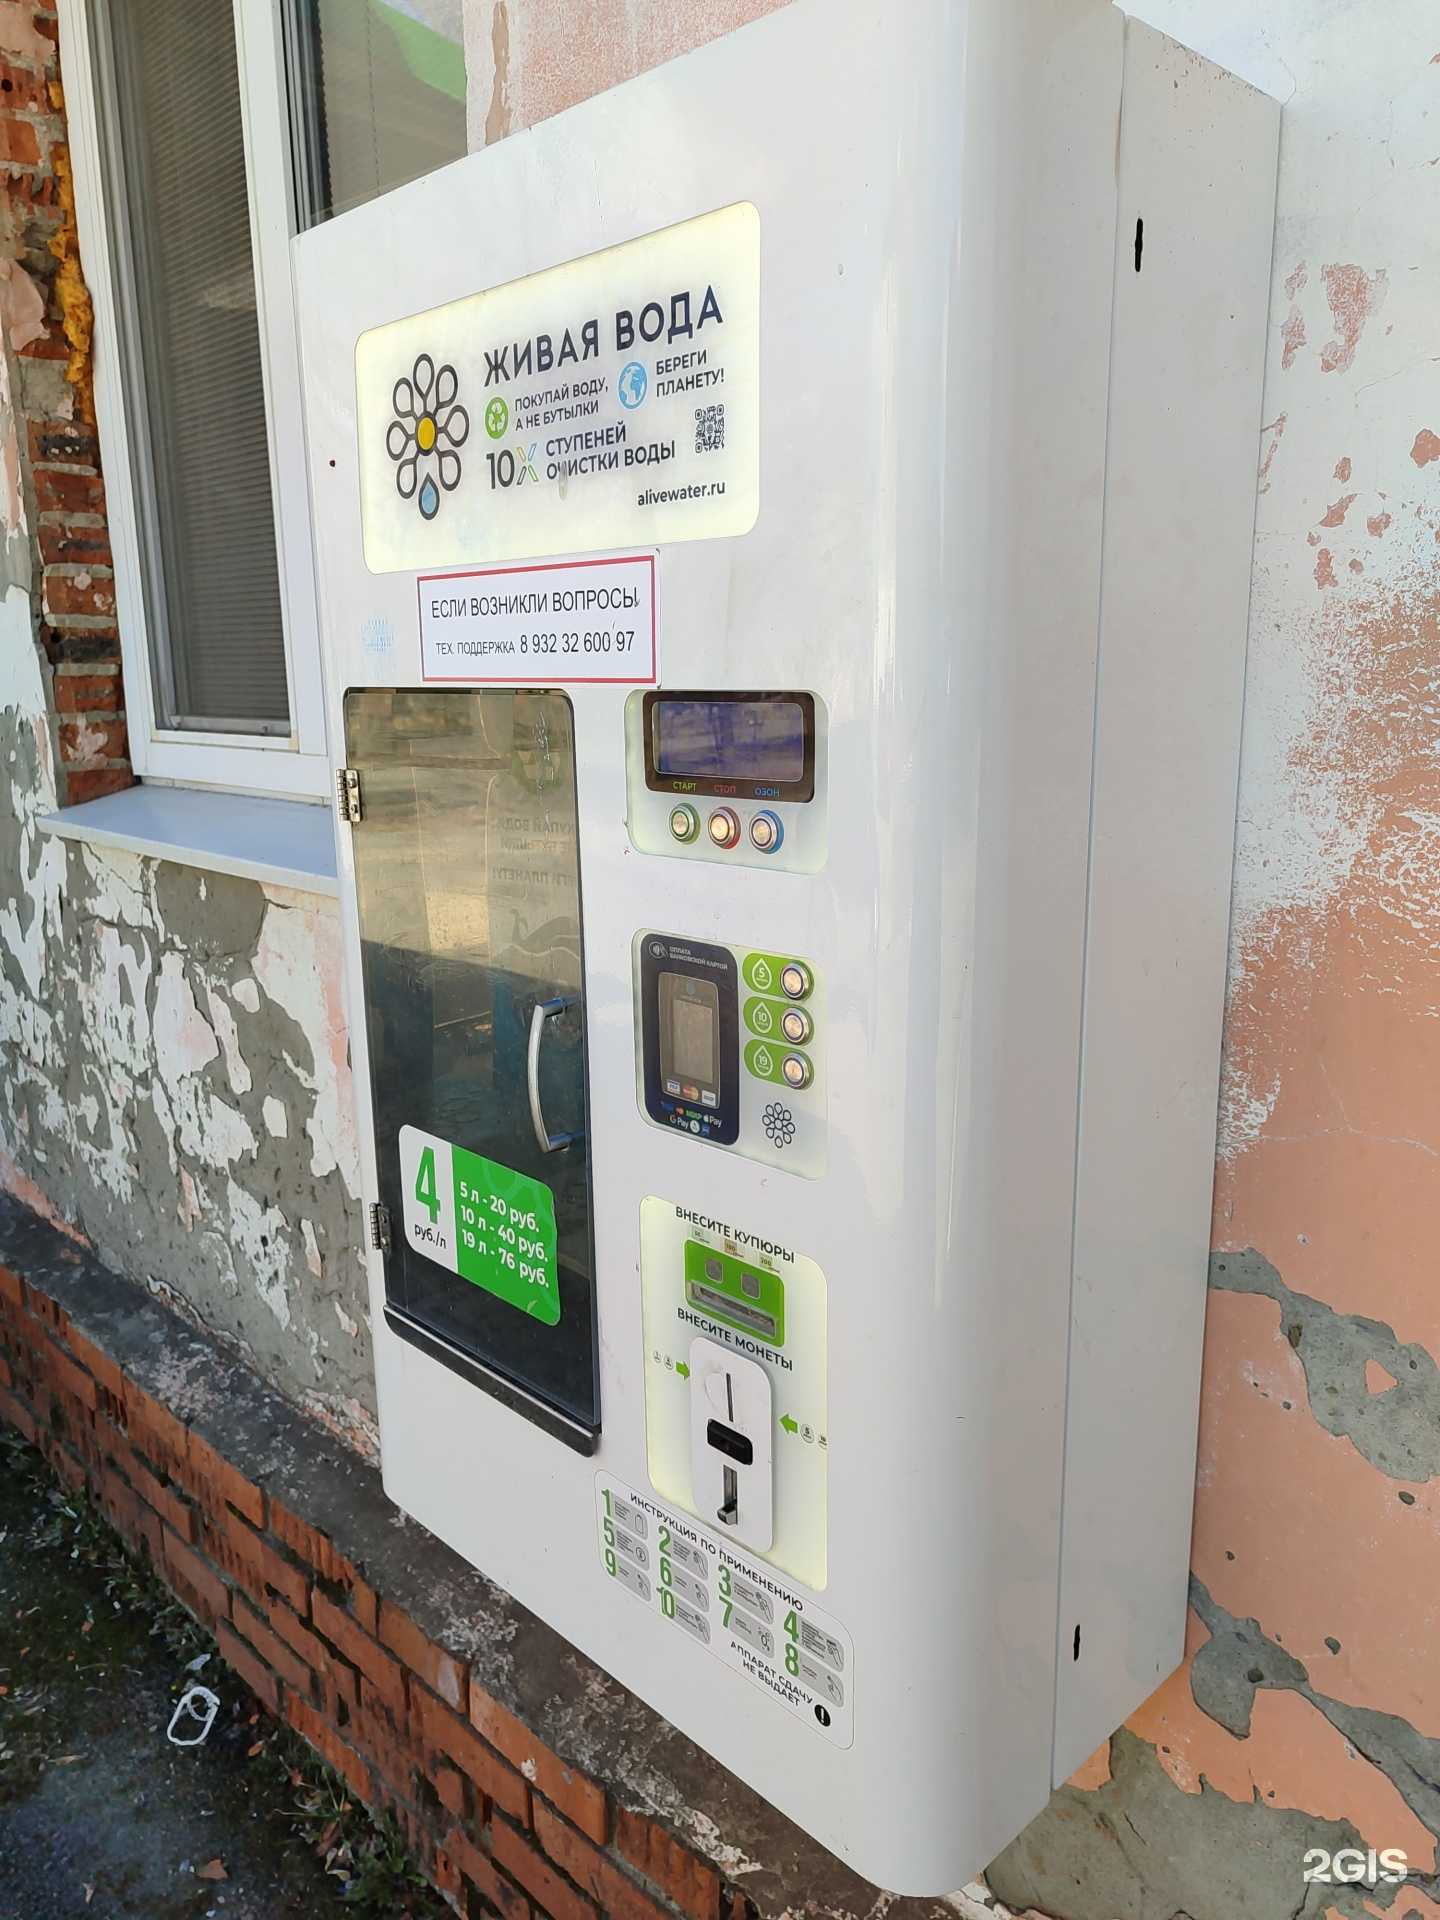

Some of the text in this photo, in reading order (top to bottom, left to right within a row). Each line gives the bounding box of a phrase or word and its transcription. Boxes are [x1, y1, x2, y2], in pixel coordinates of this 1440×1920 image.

[484, 285, 723, 387] ЖИВАЯ ВОДА
[656, 350, 707, 376] БЕРЕГИ
[515, 377, 608, 412] ПОКУПАЙ ВОДУ,
[656, 369, 724, 398] ПЛАНЕТУ!
[515, 400, 599, 431] А НЕ БУТЫЛКИ
[545, 422, 627, 458] СТУПЕНЕЙ
[546, 440, 676, 482] ОЧИСТКИ ВОДЫ
[637, 480, 726, 507] alivewater.ru
[432, 587, 638, 619] ЕСЛИ ВОЗНИКЛИ ВОПРОСЫ
[436, 631, 635, 656] ТЕХ. ПОДДЕРЖКА 8 932 32 600 97
[672, 781, 780, 797] СТАРТ СТОП ОЗОН
[759, 967, 765, 978] 5
[757, 1011, 767, 1022] 10
[758, 1055, 768, 1066] 19
[415, 1146, 440, 1224] 4
[460, 1182, 468, 1198] 5
[471, 1190, 479, 1204] л
[489, 1195, 506, 1216] 20
[509, 1208, 540, 1232] руб.
[414, 1223, 447, 1249] руб./л
[461, 1206, 475, 1225] 10
[478, 1216, 486, 1231] л
[498, 1224, 515, 1245] 40
[519, 1236, 548, 1262] руб.
[675, 1206, 795, 1263] ВНЕСИТЕ КУПЮРЫ
[462, 1230, 475, 1249] 19
[479, 1240, 487, 1255] л
[498, 1248, 515, 1269] 76
[519, 1262, 550, 1288] руб.
[677, 1308, 793, 1371] ВНЕСИТЕ МОНЕТЫ
[601, 1488, 611, 1517] 1
[603, 1517, 615, 1547] 5
[658, 1525, 671, 1557] 2
[605, 1549, 616, 1577] 9
[630, 1493, 697, 1542] ИНСТРУКЦИЯ
[701, 1538, 716, 1555] ПО
[719, 1550, 803, 1611] ПРИМЕНЕНИЮ
[659, 1557, 672, 1587] 6
[718, 1565, 731, 1597] 3
[656, 1586, 675, 1619] 10
[719, 1595, 733, 1629] 7
[783, 1610, 799, 1643] 4
[730, 1640, 775, 1679] АППАРАТ
[778, 1673, 813, 1704] СДАЧУ
[784, 1642, 799, 1677] 8
[743, 1660, 754, 1674] НЕ
[758, 1671, 800, 1707] ВЫДАЕТ
